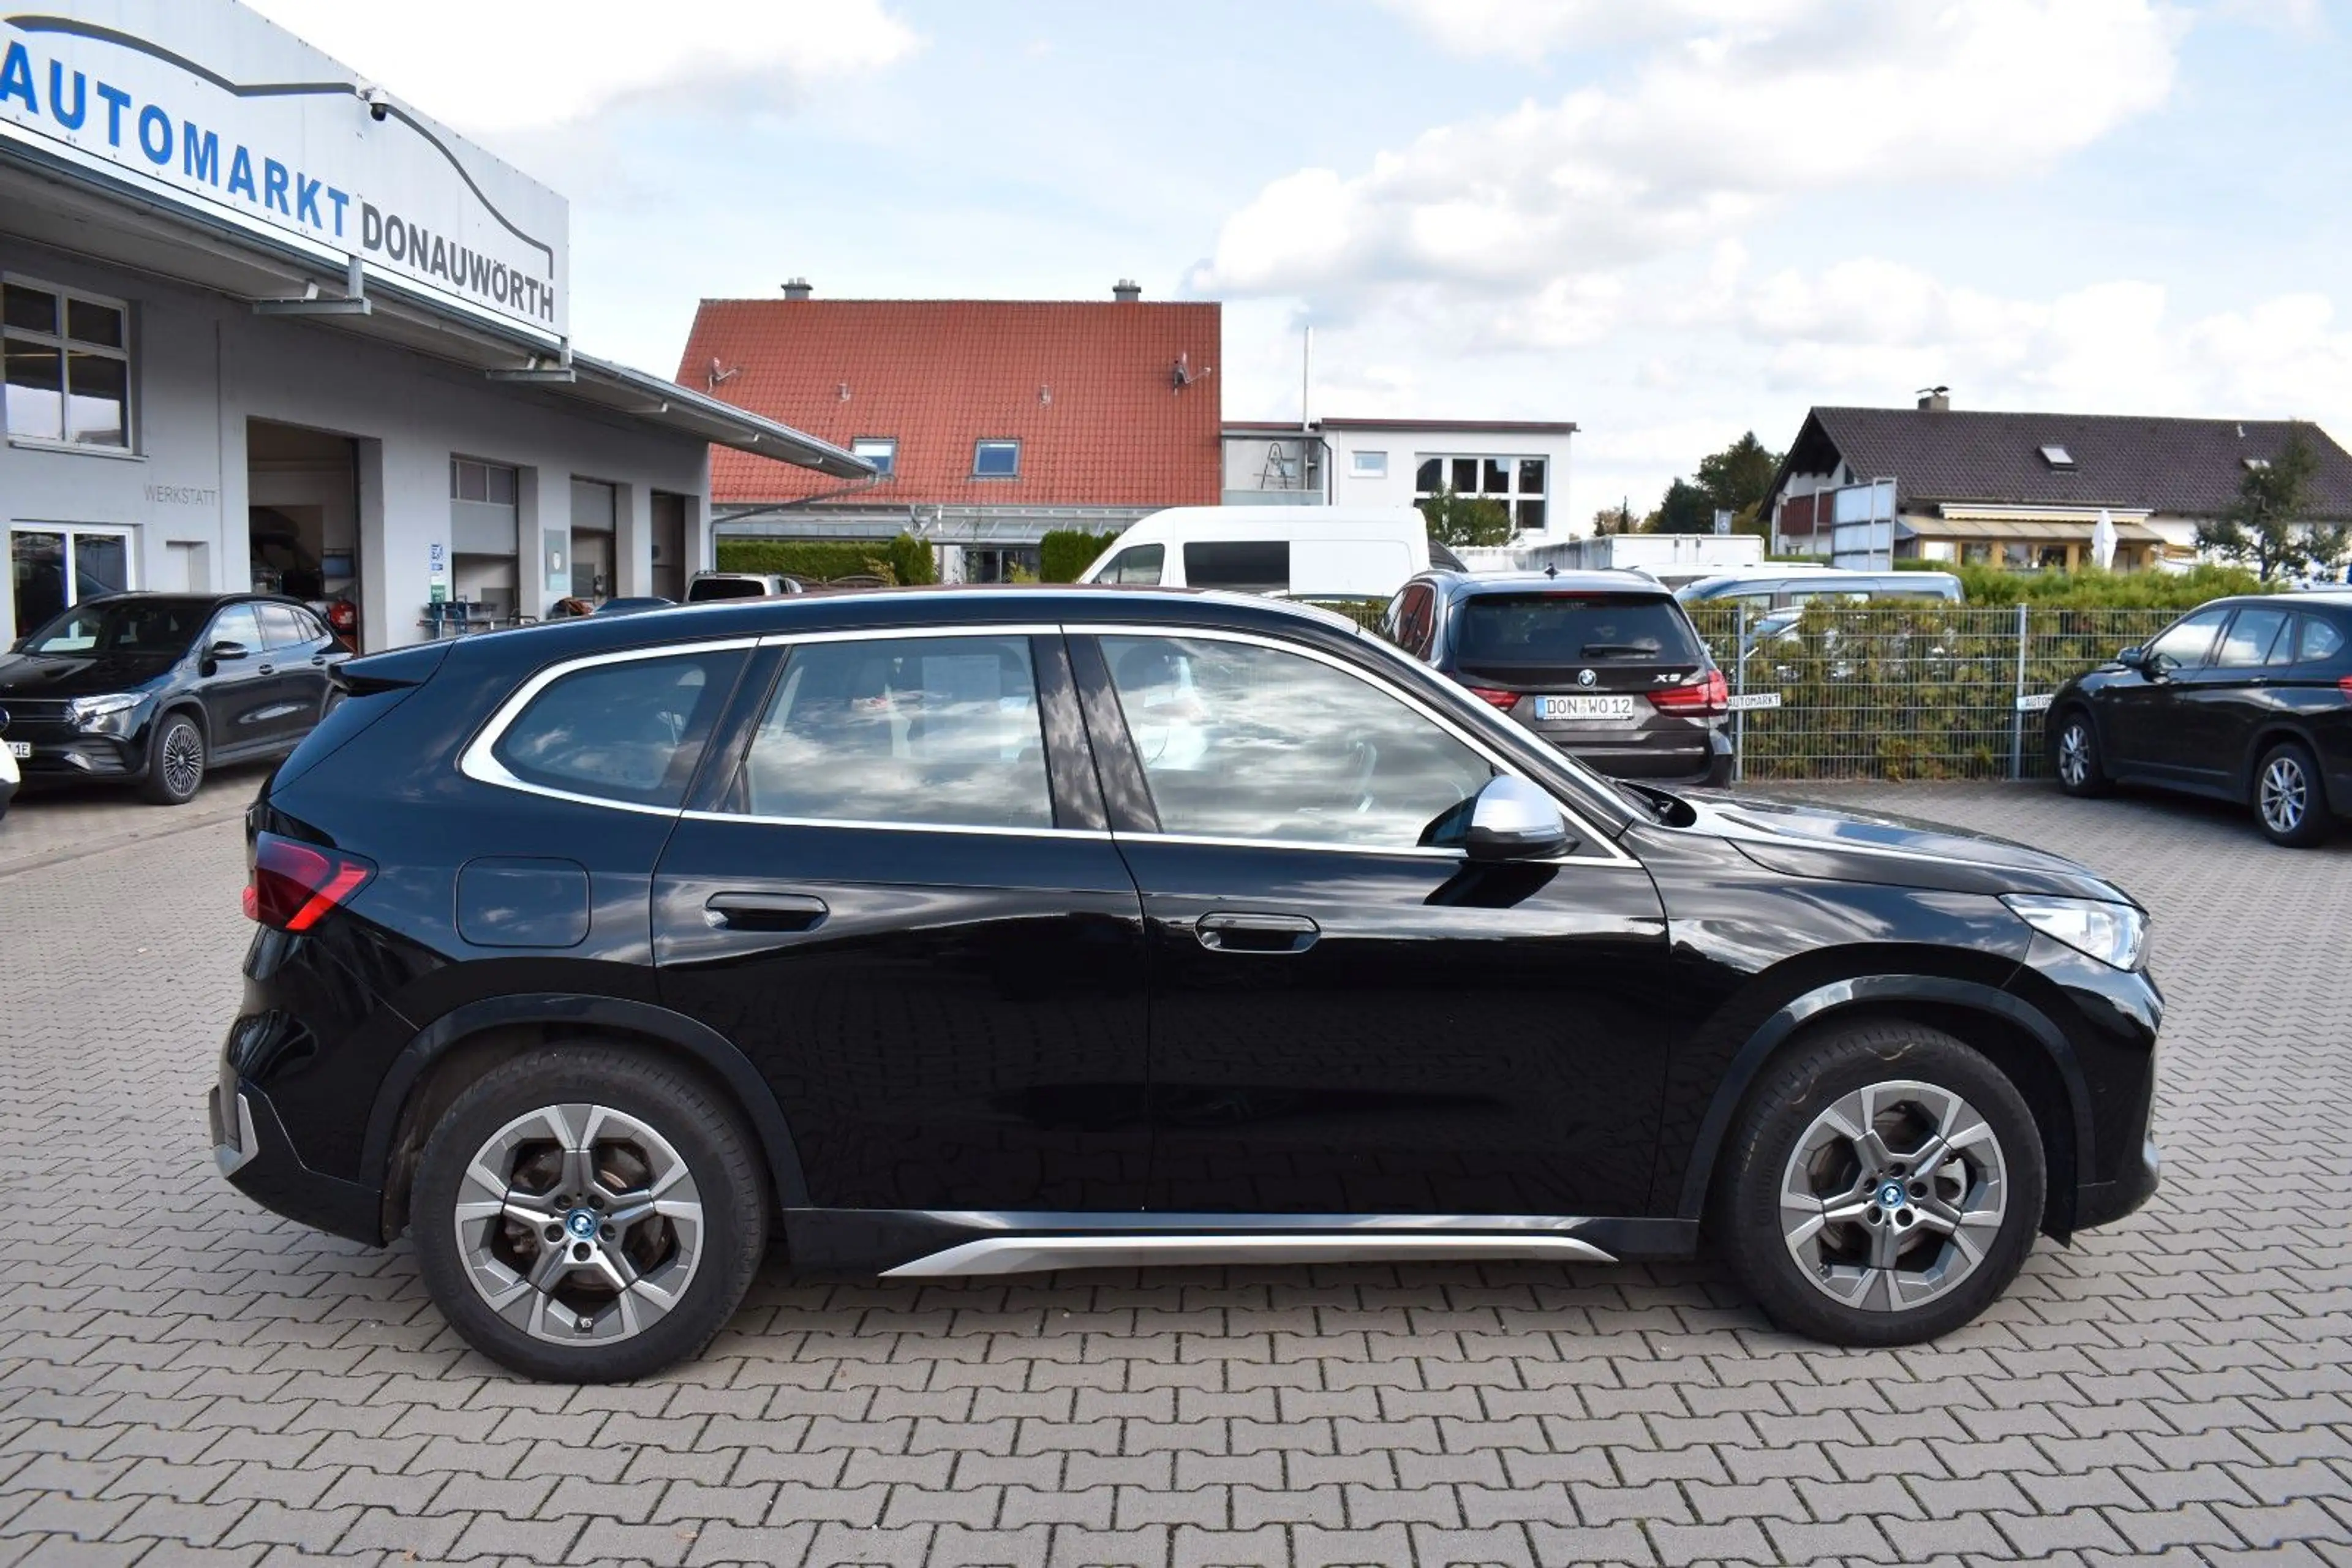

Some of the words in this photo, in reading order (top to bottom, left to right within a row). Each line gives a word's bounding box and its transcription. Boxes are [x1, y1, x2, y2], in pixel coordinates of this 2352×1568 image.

[0, 40, 350, 238] AUTOMARKT
[362, 202, 554, 323] DONAUWÖRTH
[143, 483, 217, 507] WERKSTATT
[1547, 699, 1577, 714] DON
[1588, 698, 1608, 714] WO
[1612, 698, 1631, 714] 12
